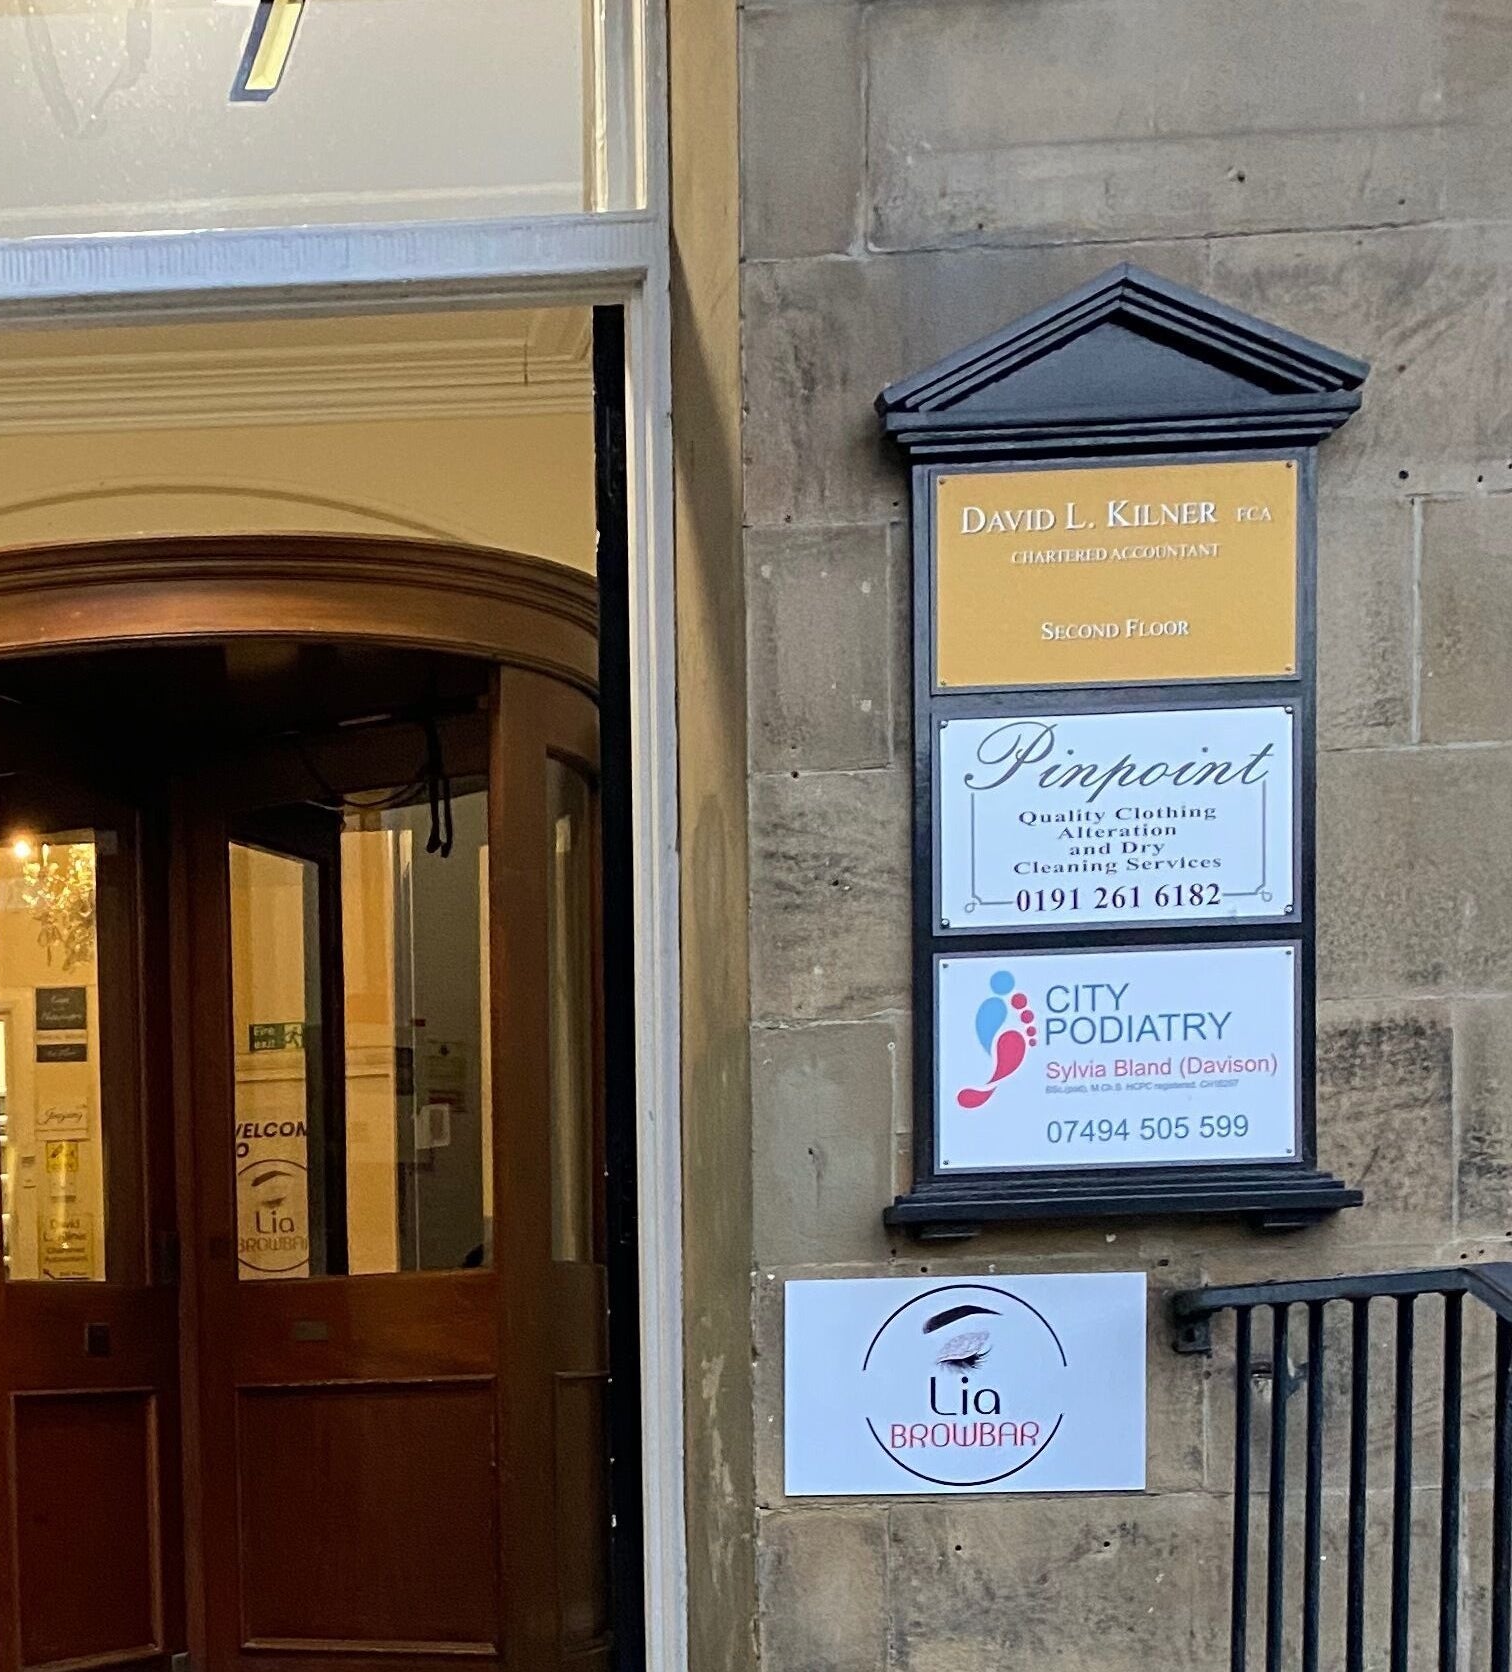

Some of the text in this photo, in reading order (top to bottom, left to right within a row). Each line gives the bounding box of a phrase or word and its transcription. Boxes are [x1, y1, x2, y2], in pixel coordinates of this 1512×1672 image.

[960, 500, 1272, 535] DAVID L. KILNER FCA
[1011, 543, 1221, 565] CHARTERED ACCOUNTANT
[1041, 618, 1189, 640] SECOND FLOOR
[963, 720, 1275, 803] Pinpoint
[1018, 805, 1217, 825] Quality Clothing
[1058, 824, 1177, 840] Alteration
[1069, 841, 1166, 857] and Dry
[1013, 856, 1222, 875] Cleaning Services
[1016, 883, 1222, 912] 0191 261 6182
[1045, 983, 1131, 1014] CITY
[1045, 1011, 1233, 1046] PODIATRY
[1045, 1053, 1278, 1083] Sylvia Bland (Davison)
[1046, 1113, 1249, 1144] 07494 505 599
[255, 1210, 295, 1234] Lia
[930, 1375, 1001, 1416] Lia
[890, 1420, 1040, 1449] BROWBAR
